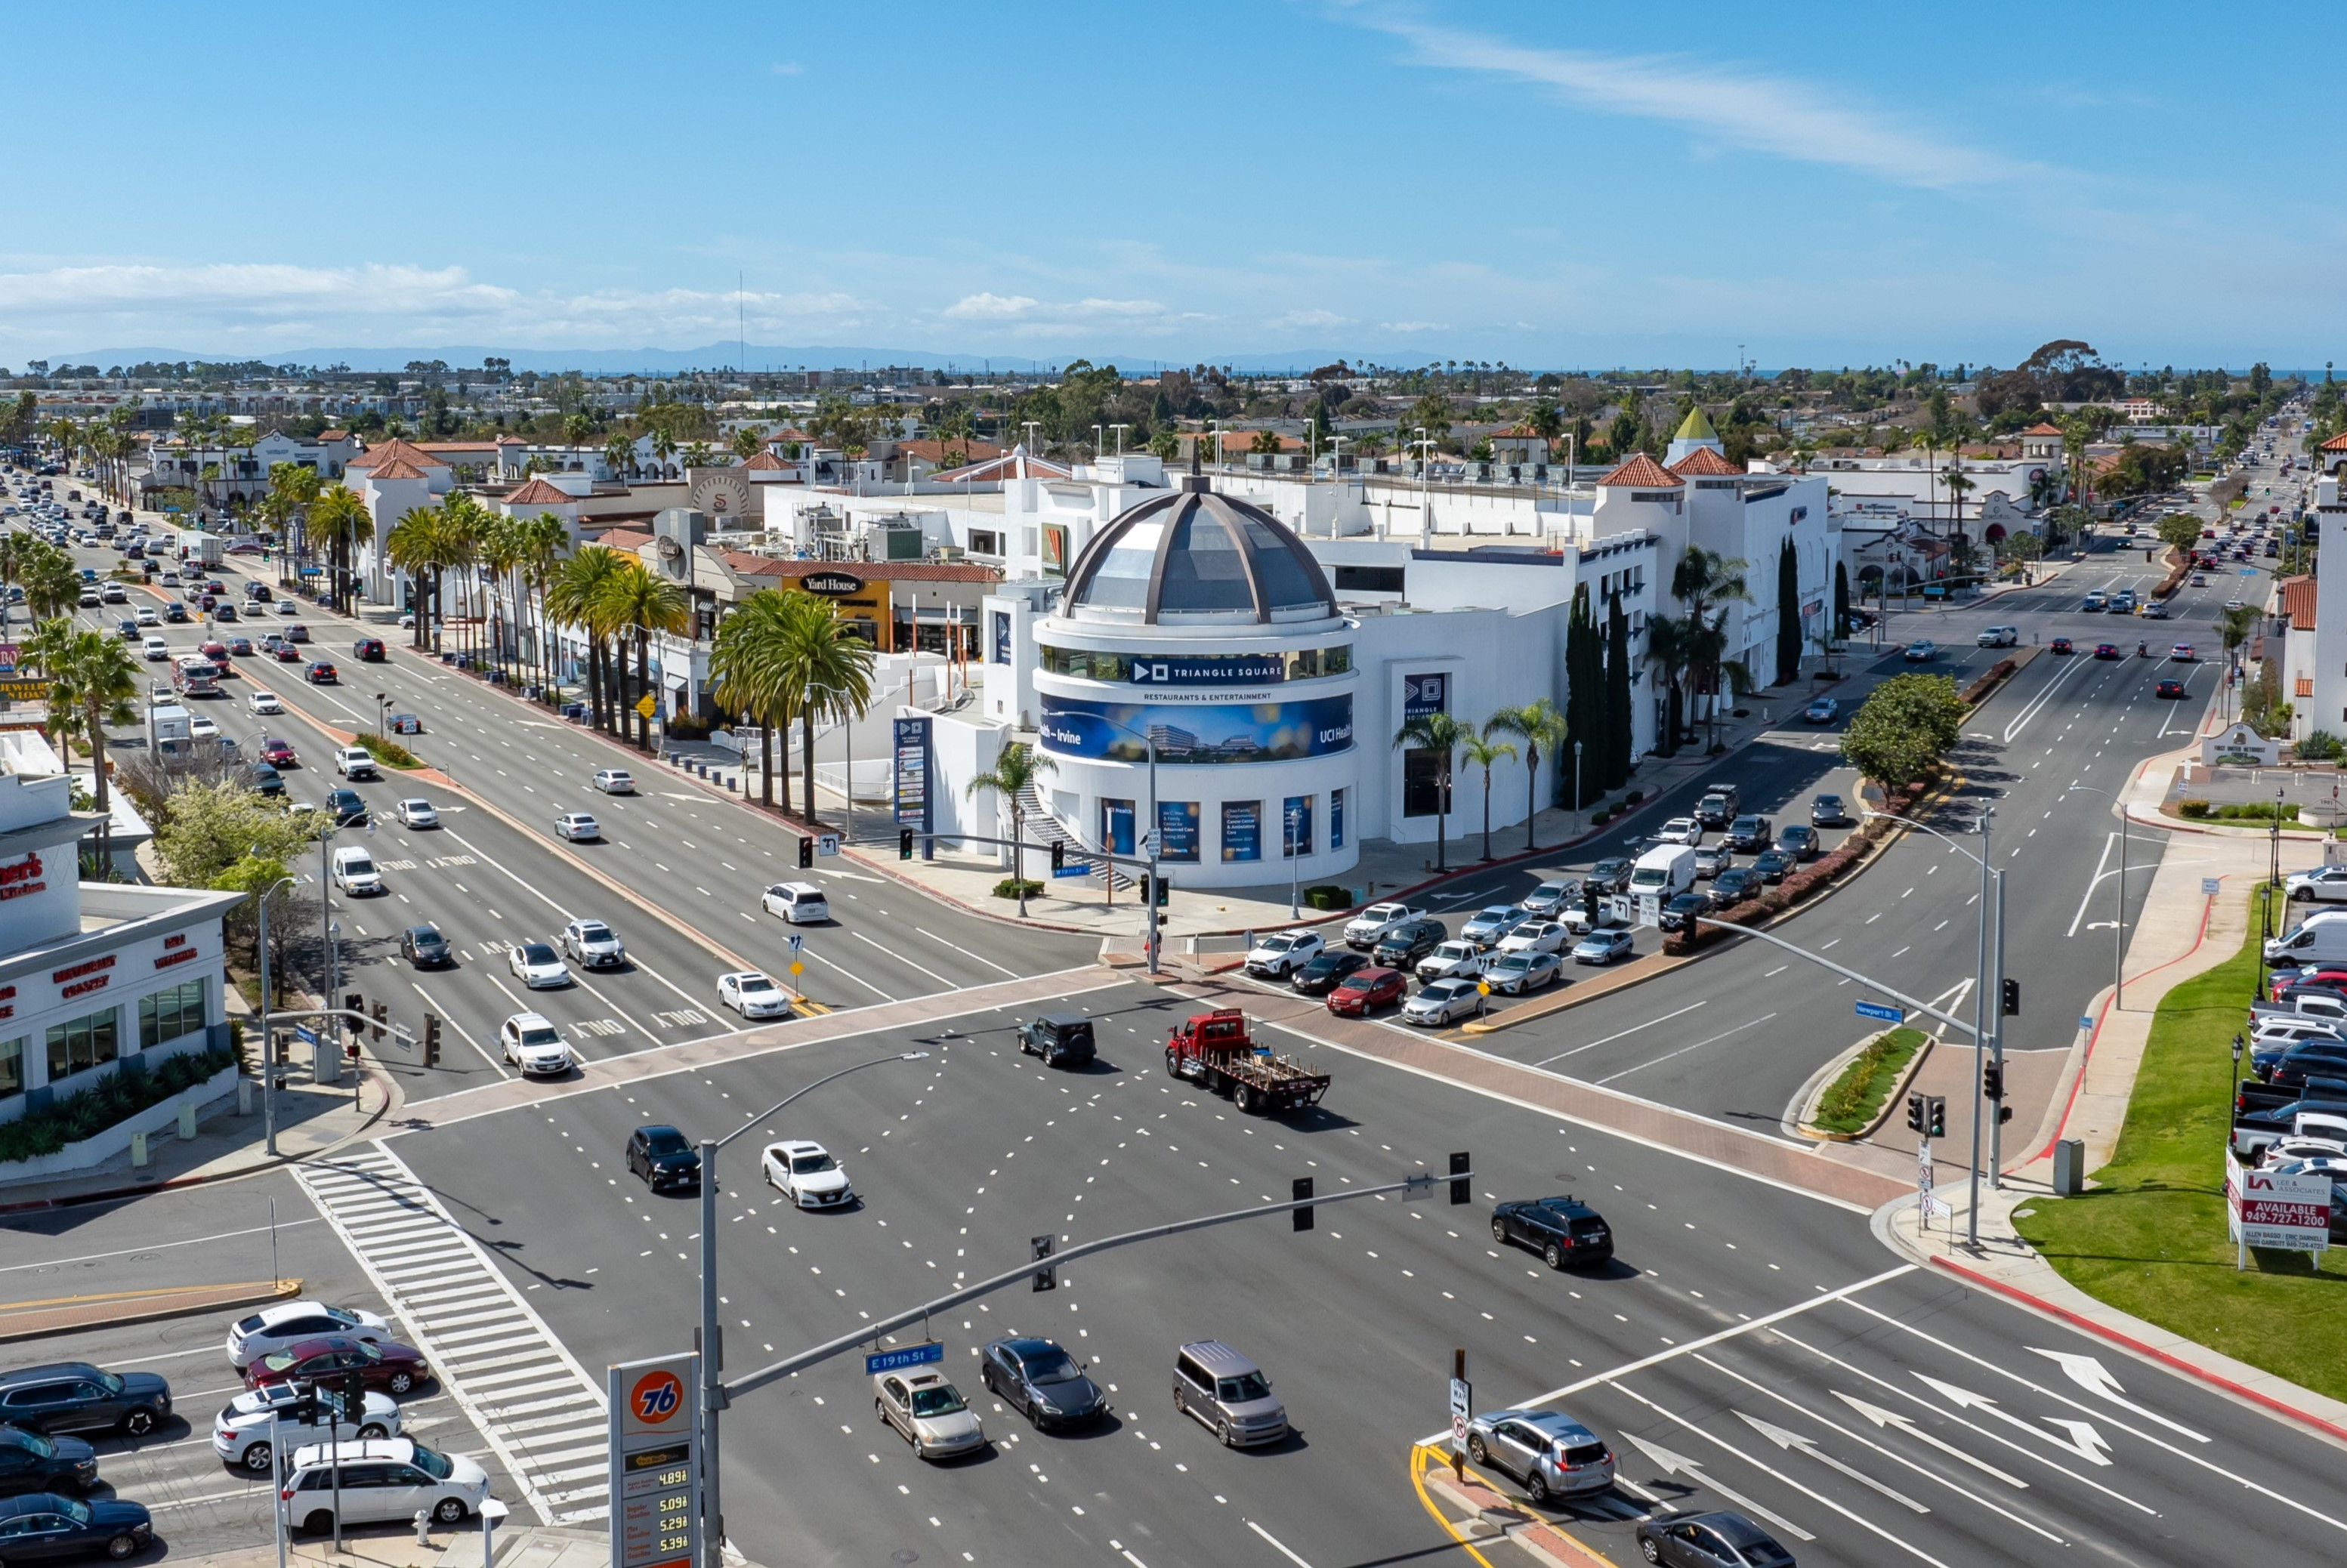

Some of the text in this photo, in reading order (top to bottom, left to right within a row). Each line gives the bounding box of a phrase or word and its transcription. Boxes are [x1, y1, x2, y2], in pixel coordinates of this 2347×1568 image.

[806, 578, 856, 591] Yard House
[1174, 667, 1282, 678] TRIANGLE SQUARE
[18, 690, 46, 699] LOAN
[1144, 693, 1200, 702] RESTAURANTS
[1209, 693, 1272, 702] ENTERTAINMENT
[1058, 728, 1081, 745] Irvine
[1320, 723, 1351, 743] UCI Health
[53, 955, 117, 984] RESTAURANT
[62, 974, 110, 999] GROCERY
[1857, 1005, 1892, 1018] Newport Bl
[650, 1009, 708, 1029] ONLY
[568, 1019, 626, 1039] ONLY
[2278, 1186, 2326, 1195] ASSOCIATES
[2255, 1202, 2317, 1215] AVAILABLE
[2246, 1211, 2325, 1226] 949-727-1200
[872, 1351, 925, 1369] E 19th St
[1453, 1379, 1465, 1390] ONE
[640, 1381, 677, 1416] 76
[1453, 1388, 1466, 1402] WAY
[627, 1504, 647, 1513] Regular
